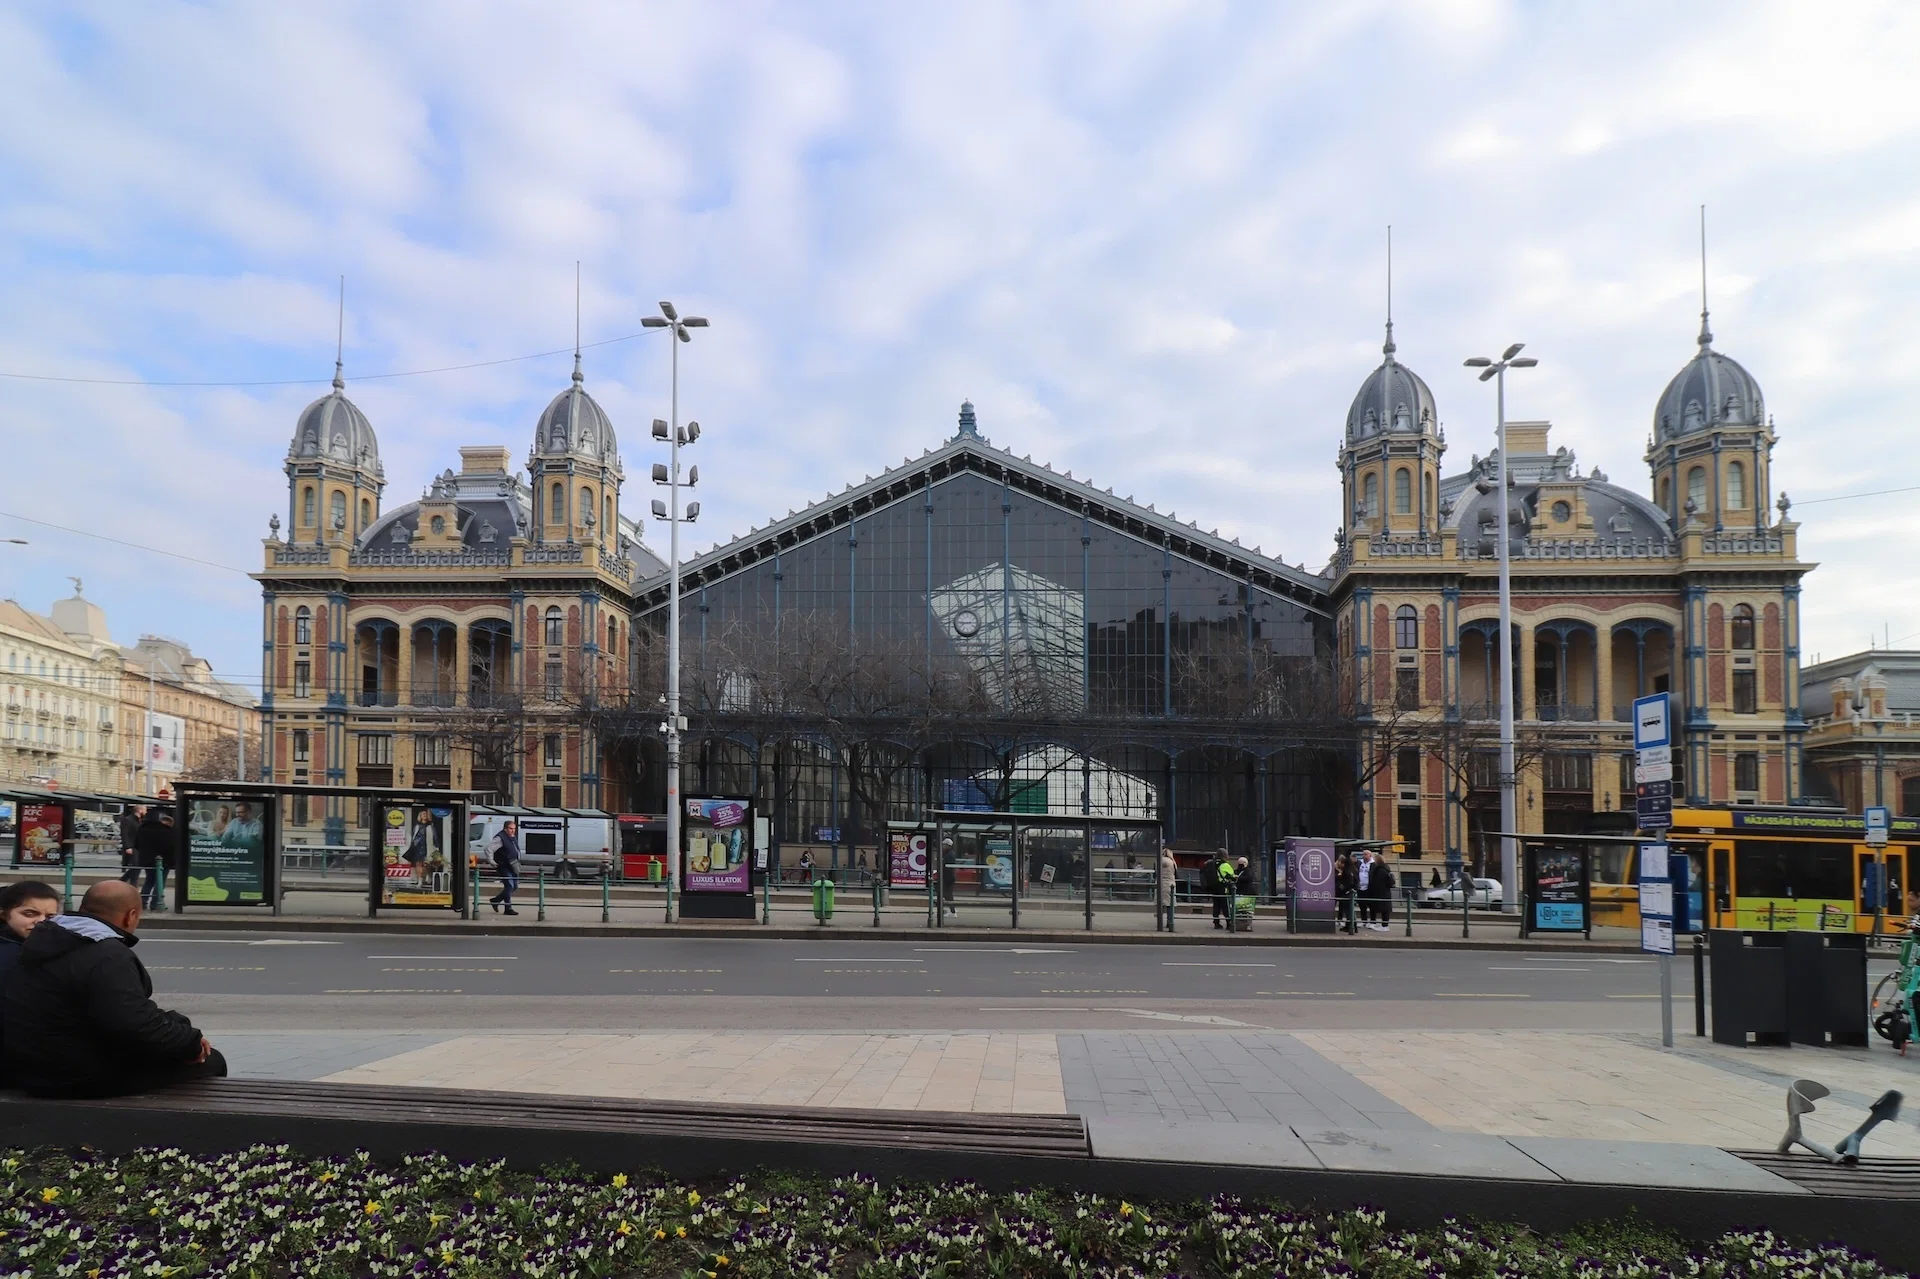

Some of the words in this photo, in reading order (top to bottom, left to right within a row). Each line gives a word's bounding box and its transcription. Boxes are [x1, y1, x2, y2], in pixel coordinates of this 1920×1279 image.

[717, 808, 734, 819] 25%
[1744, 814, 1793, 826] HÁZASSÁGI
[1793, 815, 1845, 828] ÉVFORDULÓ
[894, 845, 908, 853] 30
[908, 835, 926, 871] 8
[692, 876, 715, 884] LUXUS
[714, 876, 743, 884] ILLATOK
